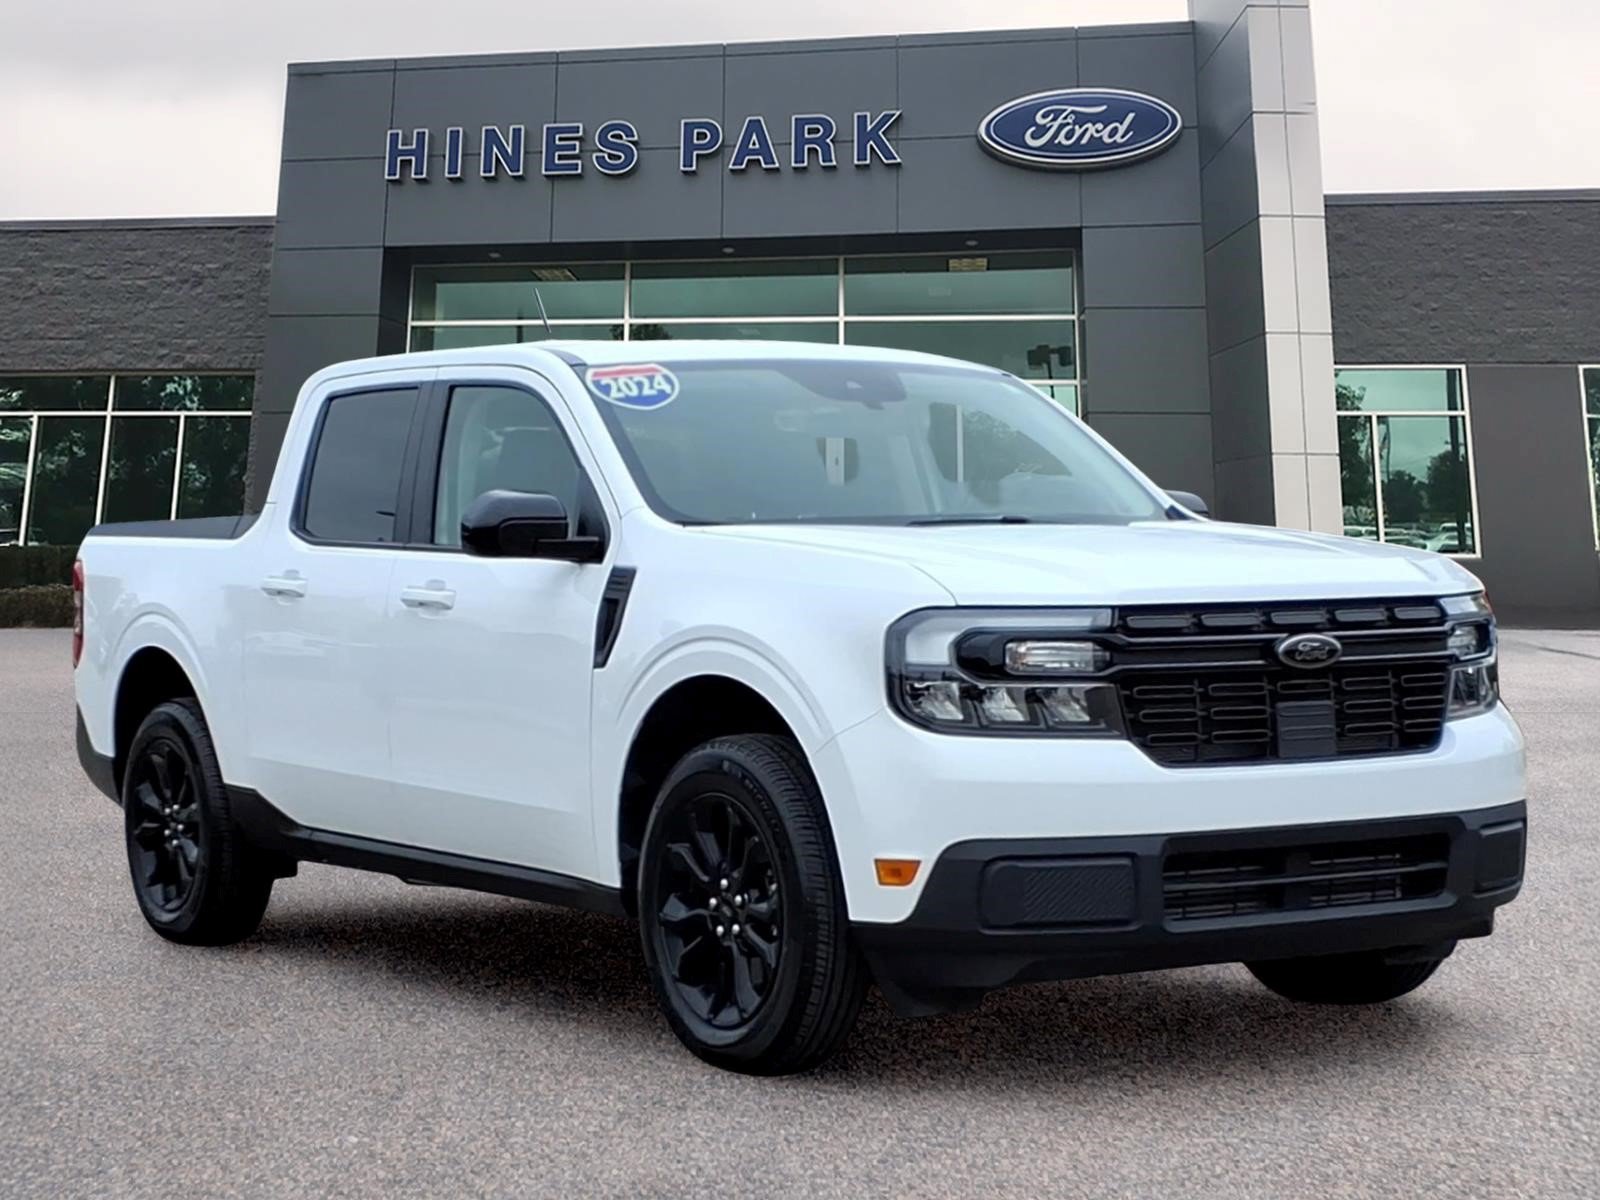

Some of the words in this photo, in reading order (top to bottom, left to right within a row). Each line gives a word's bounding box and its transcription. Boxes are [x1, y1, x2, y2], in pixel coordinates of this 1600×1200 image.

[384, 120, 639, 181] HINES
[679, 110, 903, 173] PARK
[1024, 104, 1136, 148] Ford
[601, 374, 672, 399] 2024
